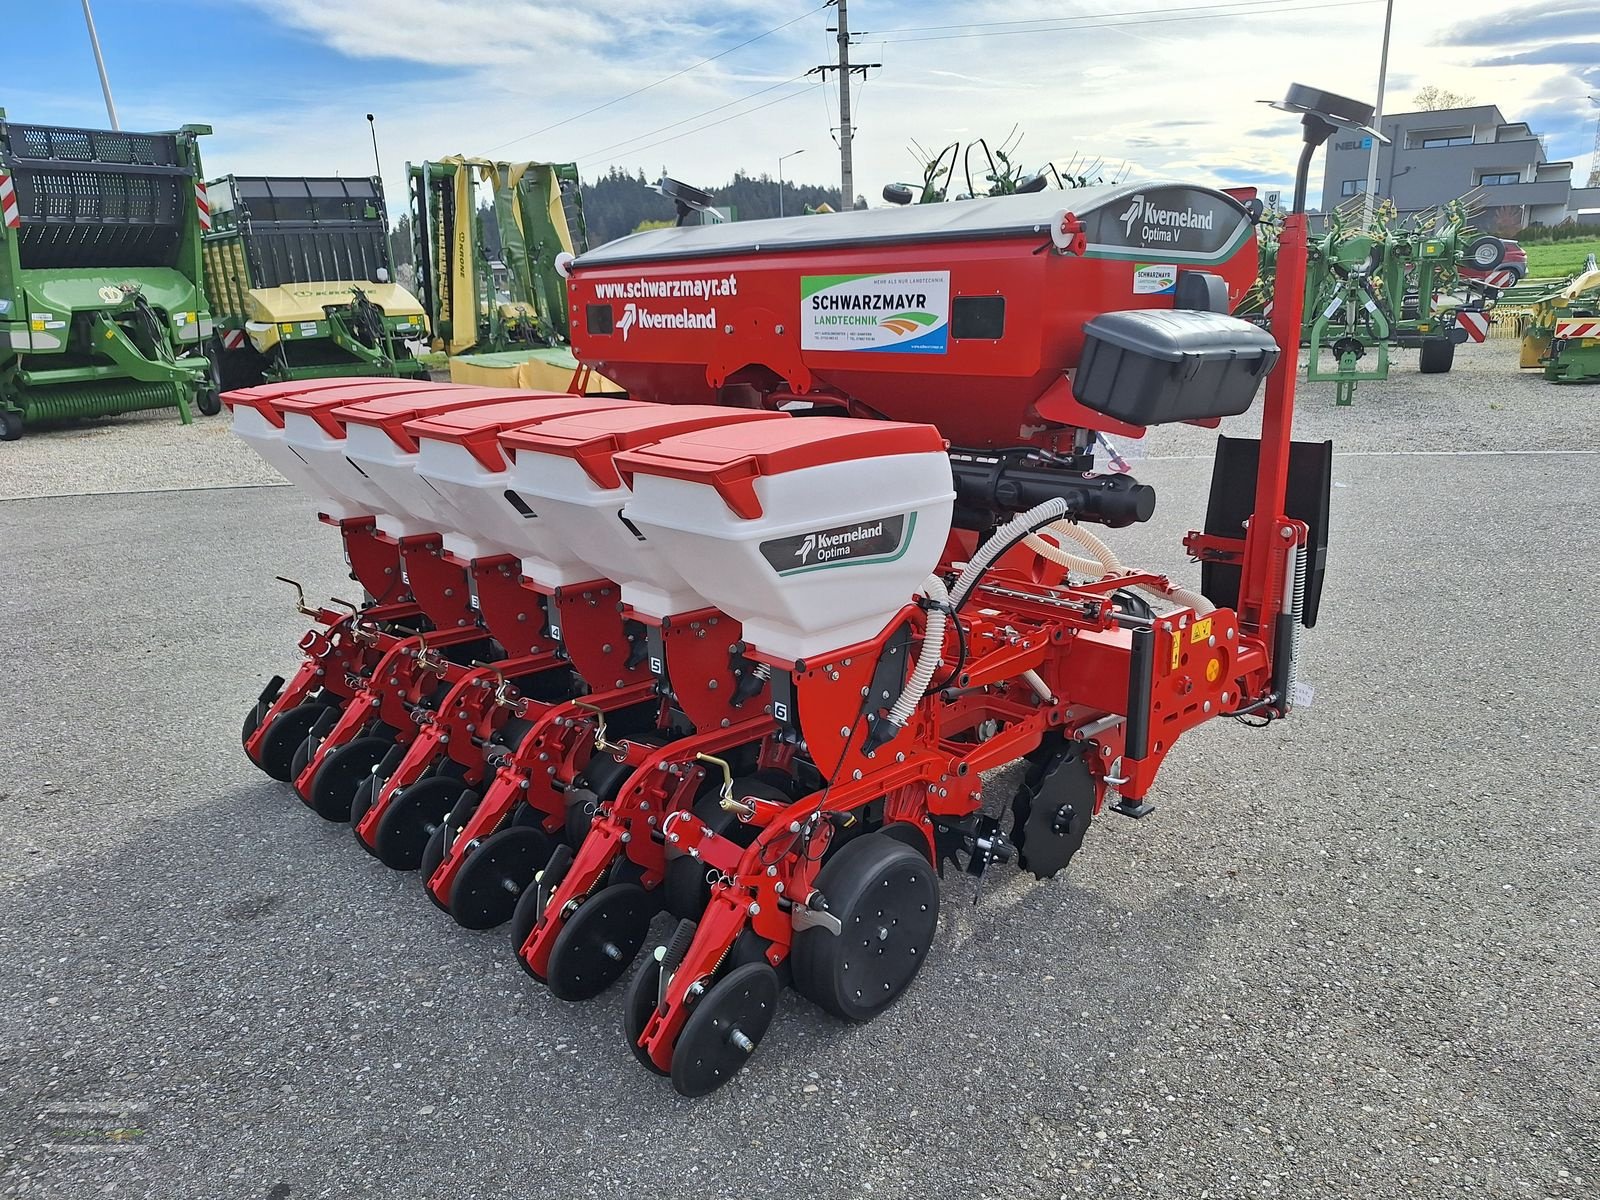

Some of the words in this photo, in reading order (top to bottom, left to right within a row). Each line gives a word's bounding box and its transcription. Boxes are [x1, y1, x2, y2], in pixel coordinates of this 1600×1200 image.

[1143, 202, 1213, 230] Kverneland
[1141, 225, 1171, 243] Optima
[1173, 228, 1181, 242] V
[595, 273, 737, 301] www.schwarzmayr.at
[812, 293, 927, 310] SCHWARZMAYR
[638, 307, 716, 329] Kverneland
[814, 315, 878, 325] LANDTECHNIK
[817, 522, 883, 549] Kverneland
[817, 545, 851, 562] Optima
[552, 628, 559, 639] 4
[652, 660, 660, 671] 5
[776, 705, 785, 718] 6
